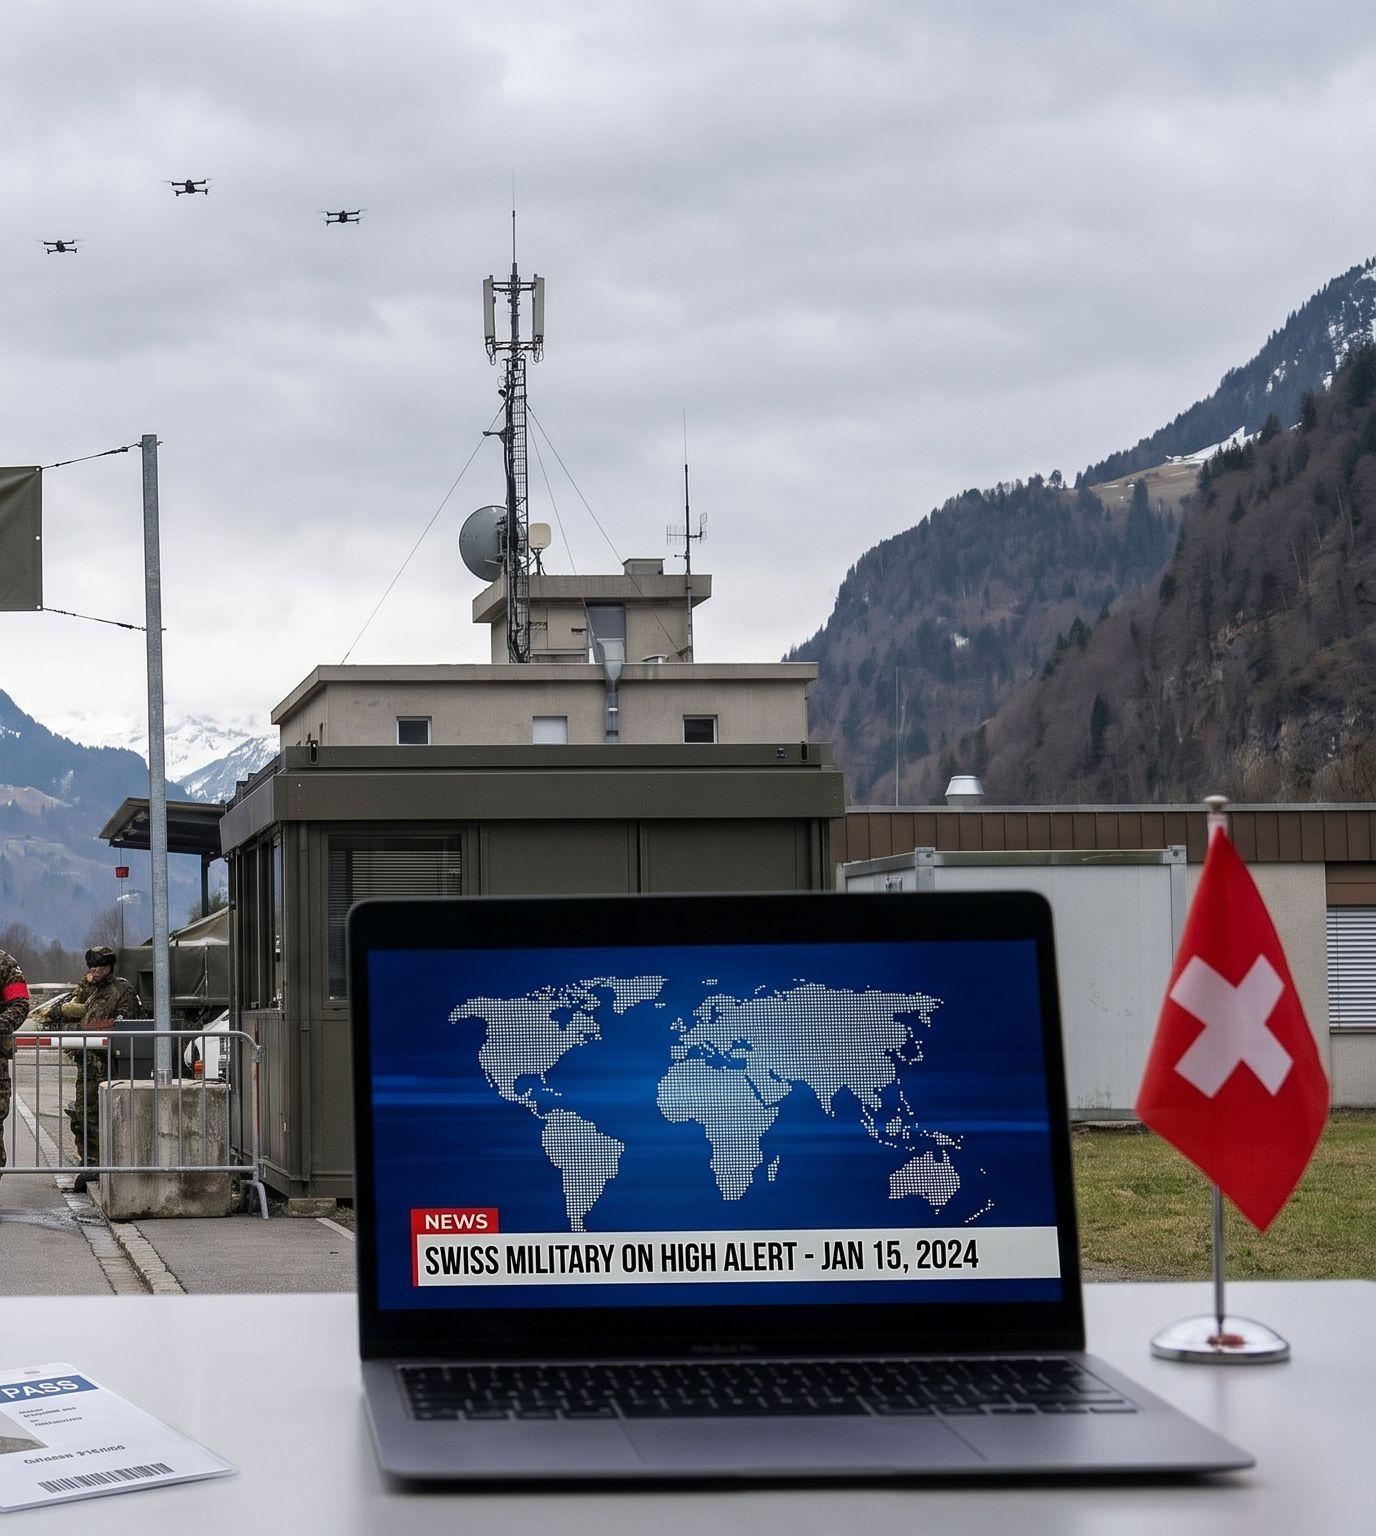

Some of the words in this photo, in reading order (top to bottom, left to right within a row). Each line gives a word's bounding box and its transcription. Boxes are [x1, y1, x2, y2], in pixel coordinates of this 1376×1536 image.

[425, 1213, 488, 1230] NEWS
[425, 1245, 500, 1276] SWISS
[506, 1244, 615, 1275] MILITARY
[621, 1243, 654, 1273] ON
[660, 1242, 717, 1273] HIGH
[723, 1241, 798, 1272] ALERT
[821, 1240, 864, 1271] JAN
[873, 1240, 909, 1274] 15,
[916, 1239, 979, 1269] 2024
[2, 1380, 79, 1399] PASS
